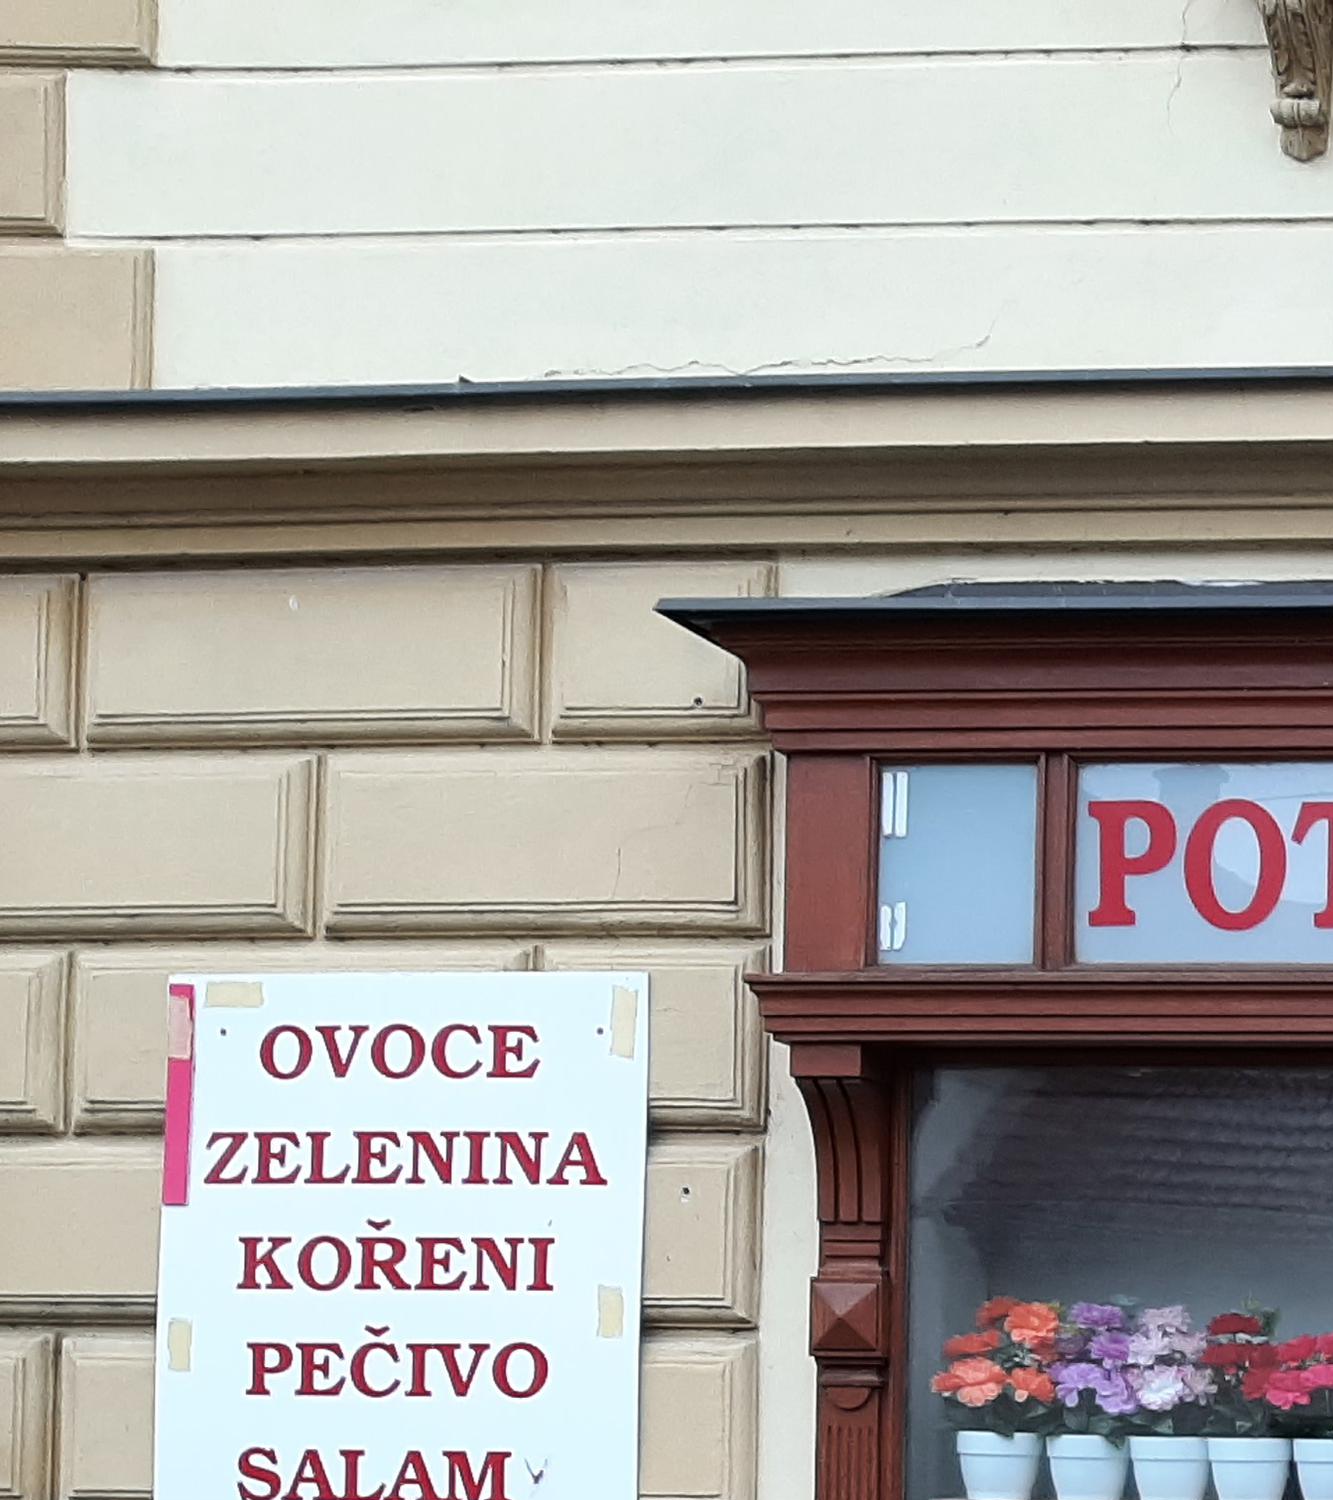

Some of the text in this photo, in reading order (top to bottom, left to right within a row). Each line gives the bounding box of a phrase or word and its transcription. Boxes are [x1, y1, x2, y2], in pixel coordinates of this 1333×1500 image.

[259, 1024, 541, 1081] OVOCE
[204, 1131, 609, 1187] ZELENINA
[245, 1326, 550, 1400] PEČIVO
